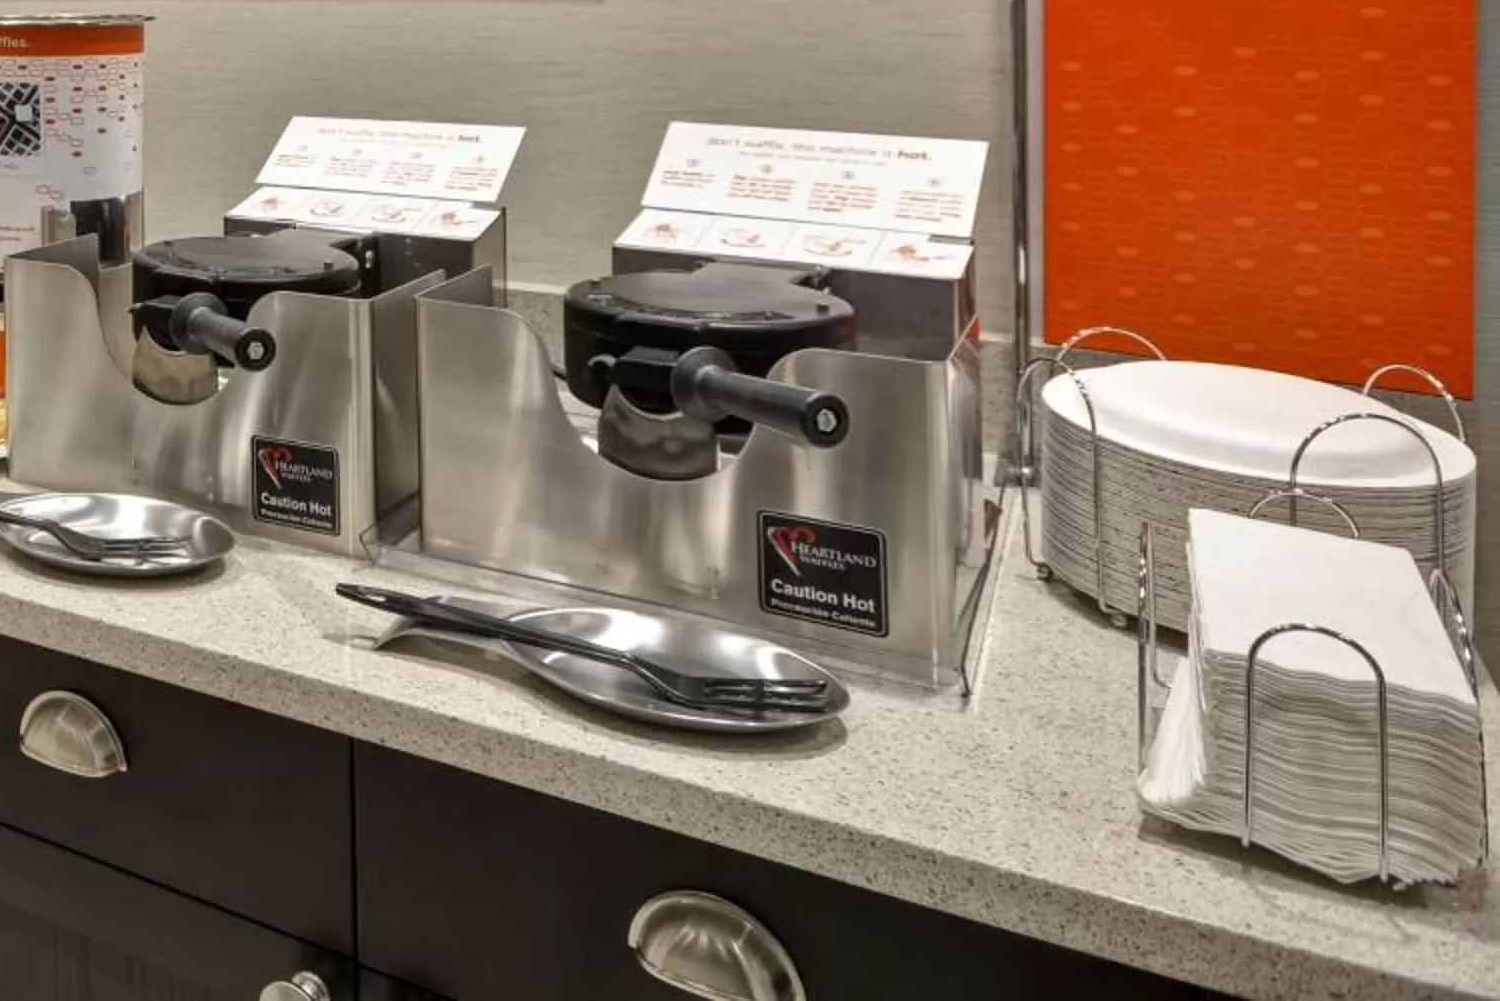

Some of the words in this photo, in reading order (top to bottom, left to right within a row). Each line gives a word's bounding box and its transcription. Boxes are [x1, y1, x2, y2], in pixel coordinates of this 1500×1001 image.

[261, 492, 307, 512] Caution
[309, 500, 333, 518] Hot
[791, 540, 877, 568] HEARTLAND
[771, 578, 838, 605] Caution
[843, 592, 875, 613] Hot
